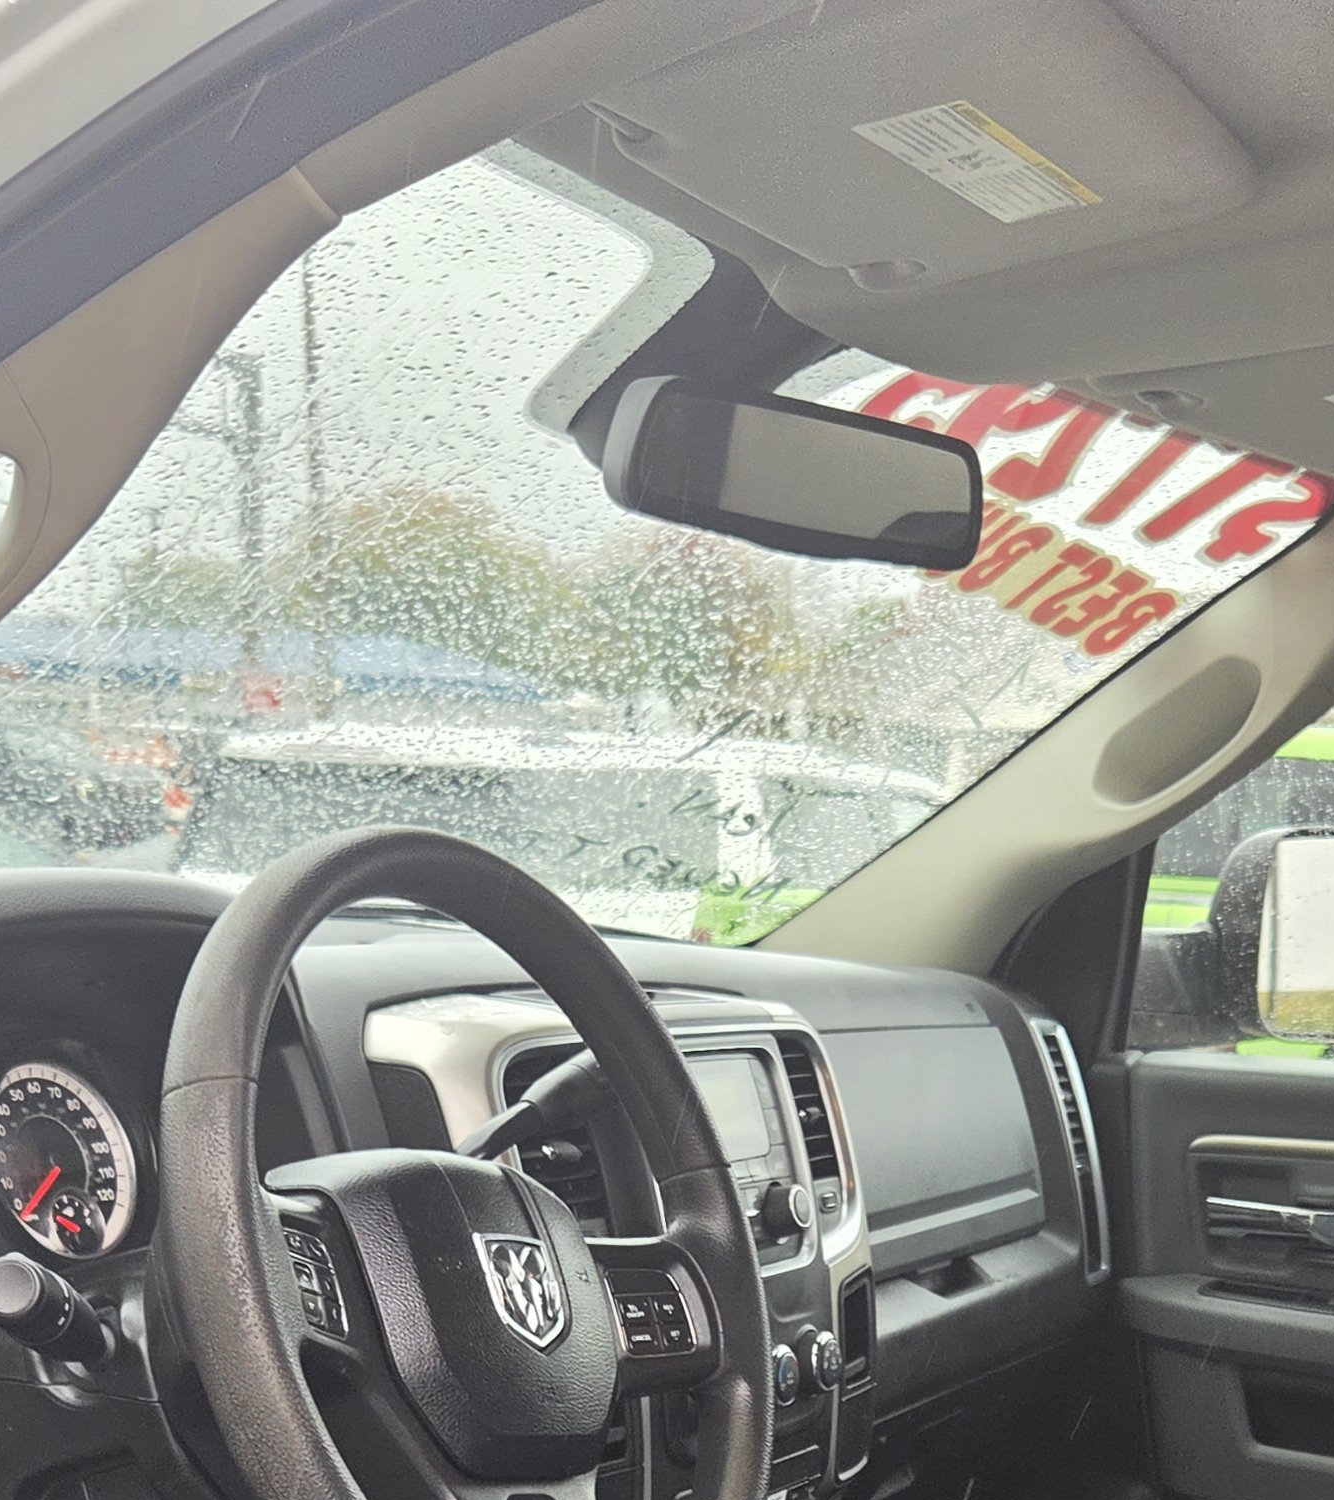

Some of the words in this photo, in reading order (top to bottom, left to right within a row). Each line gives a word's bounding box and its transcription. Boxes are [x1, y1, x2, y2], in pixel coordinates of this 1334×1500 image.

[27, 1081, 42, 1094] 60
[47, 1086, 62, 1099] 70
[8, 1089, 24, 1102] 50
[67, 1099, 81, 1112] 80
[82, 1117, 97, 1129] 90
[91, 1142, 109, 1155] 100
[98, 1166, 115, 1179] 110
[0, 1176, 14, 1190] 10
[96, 1187, 115, 1201] 120
[13, 1198, 23, 1211] 0
